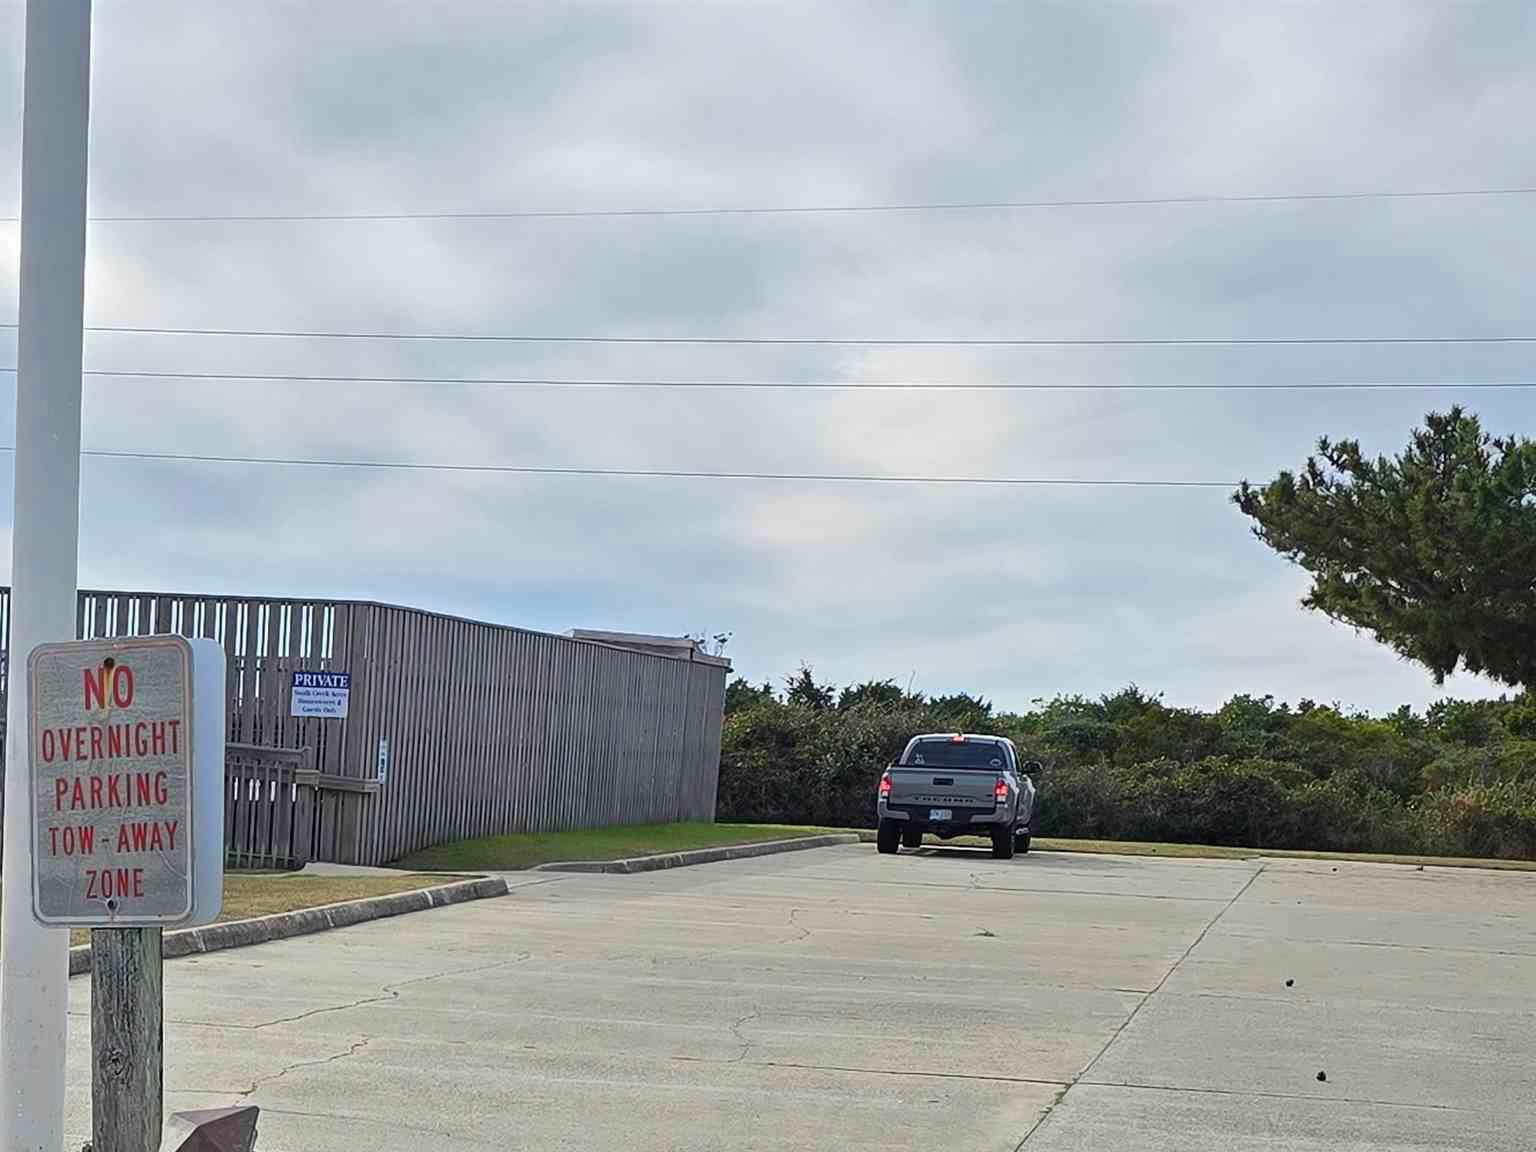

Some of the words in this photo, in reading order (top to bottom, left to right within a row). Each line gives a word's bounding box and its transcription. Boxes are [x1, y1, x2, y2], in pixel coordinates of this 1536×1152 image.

[84, 665, 134, 711] NO
[295, 673, 349, 688] PRIVATE
[42, 720, 181, 763] OVERNIGHT
[55, 771, 168, 812] PARKING
[86, 868, 144, 899] ZONE
